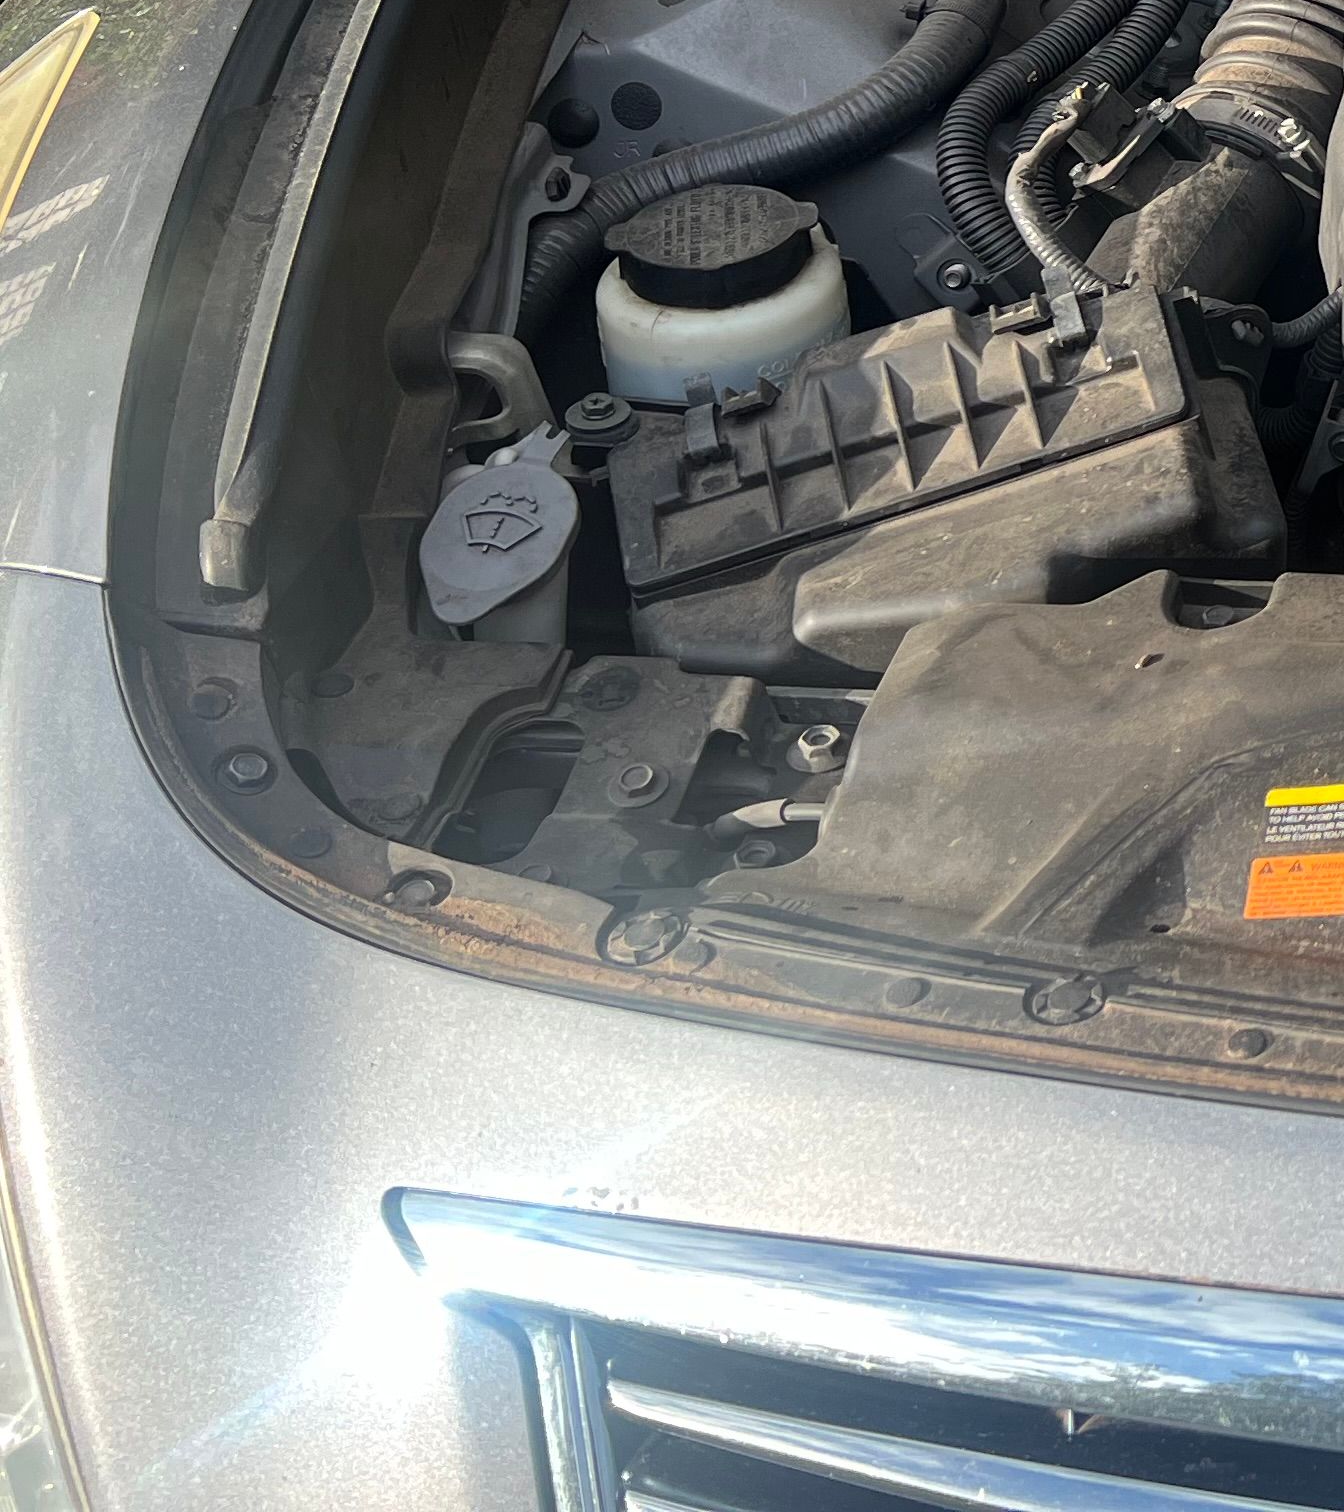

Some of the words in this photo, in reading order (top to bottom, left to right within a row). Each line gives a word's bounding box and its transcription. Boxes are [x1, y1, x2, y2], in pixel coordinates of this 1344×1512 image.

[1269, 807, 1288, 816] FAN
[1318, 804, 1337, 813] CAN
[1268, 816, 1281, 824] TO
[1281, 815, 1305, 823] HELP
[1266, 826, 1278, 835] LE
[1264, 834, 1292, 843] POUR
